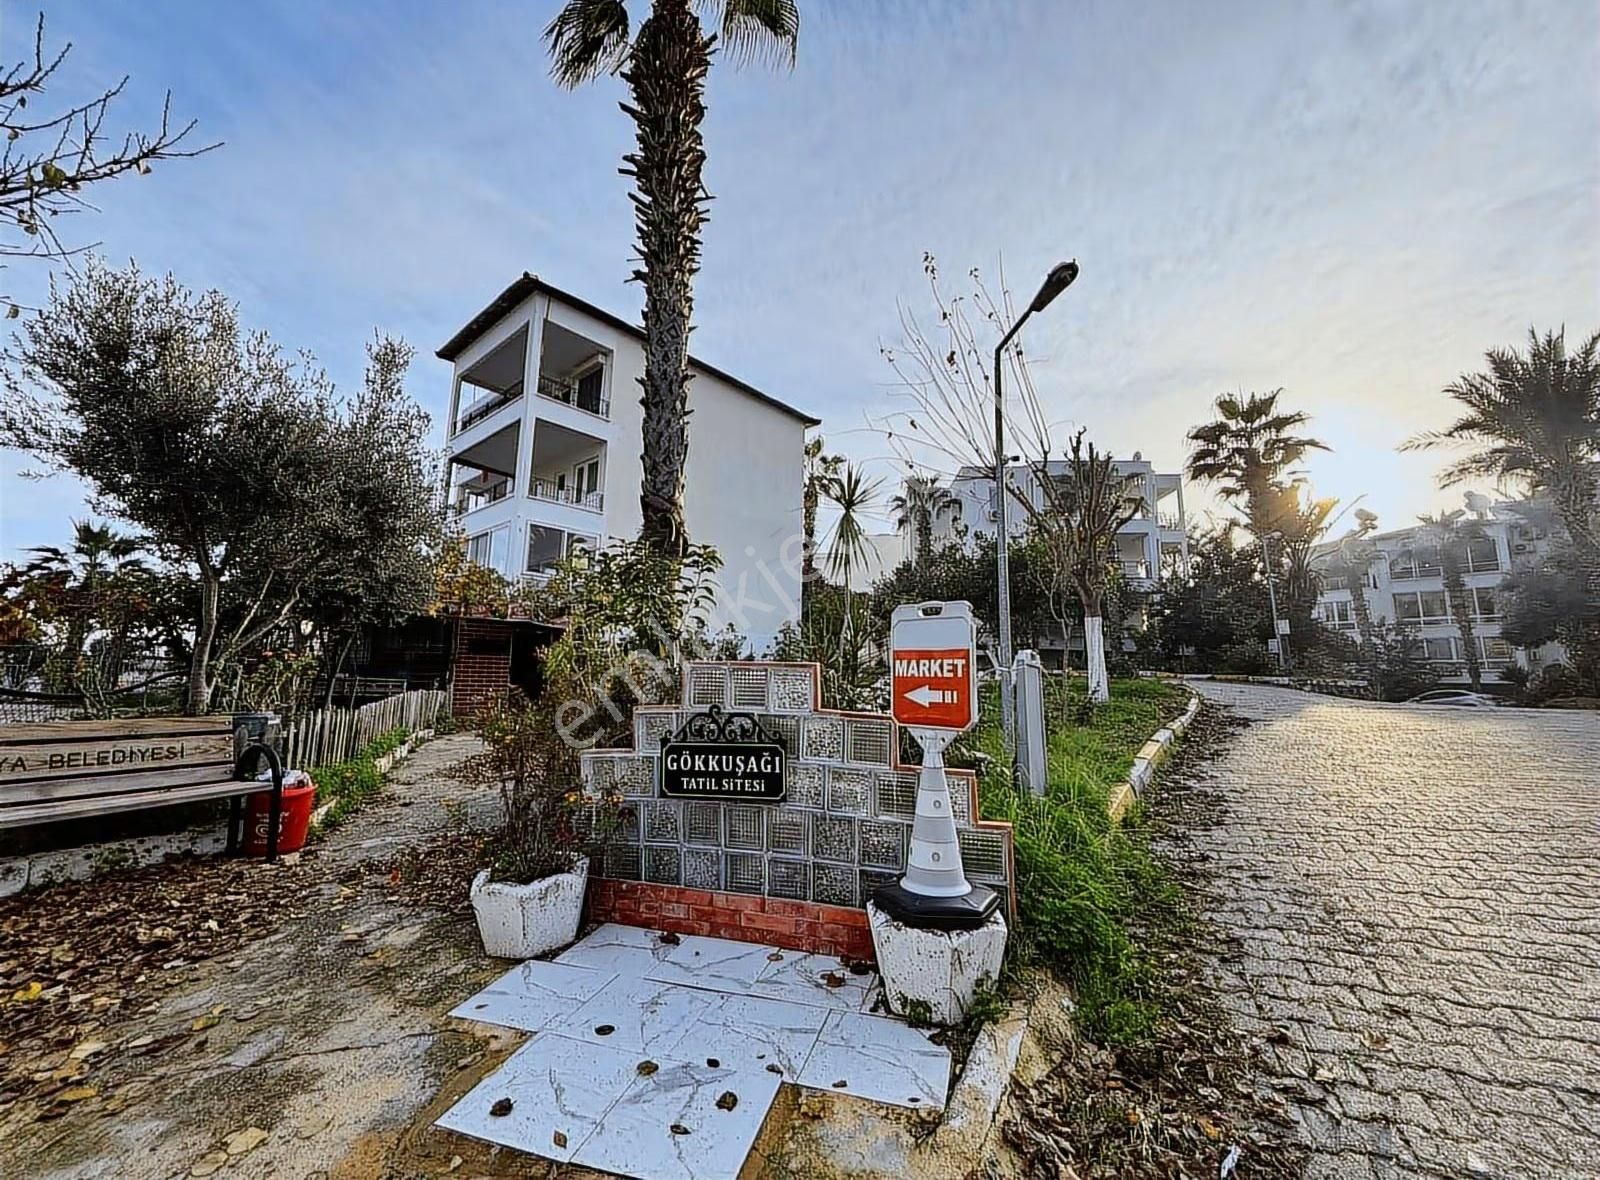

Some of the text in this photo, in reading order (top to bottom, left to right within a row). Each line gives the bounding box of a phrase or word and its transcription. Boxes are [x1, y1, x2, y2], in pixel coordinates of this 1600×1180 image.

[894, 658, 966, 678] MARKET
[48, 742, 185, 769] BELEDİYESİ
[667, 750, 780, 777] GÖKKUŞAĞI
[681, 777, 765, 792] TATİL SİTESİ
